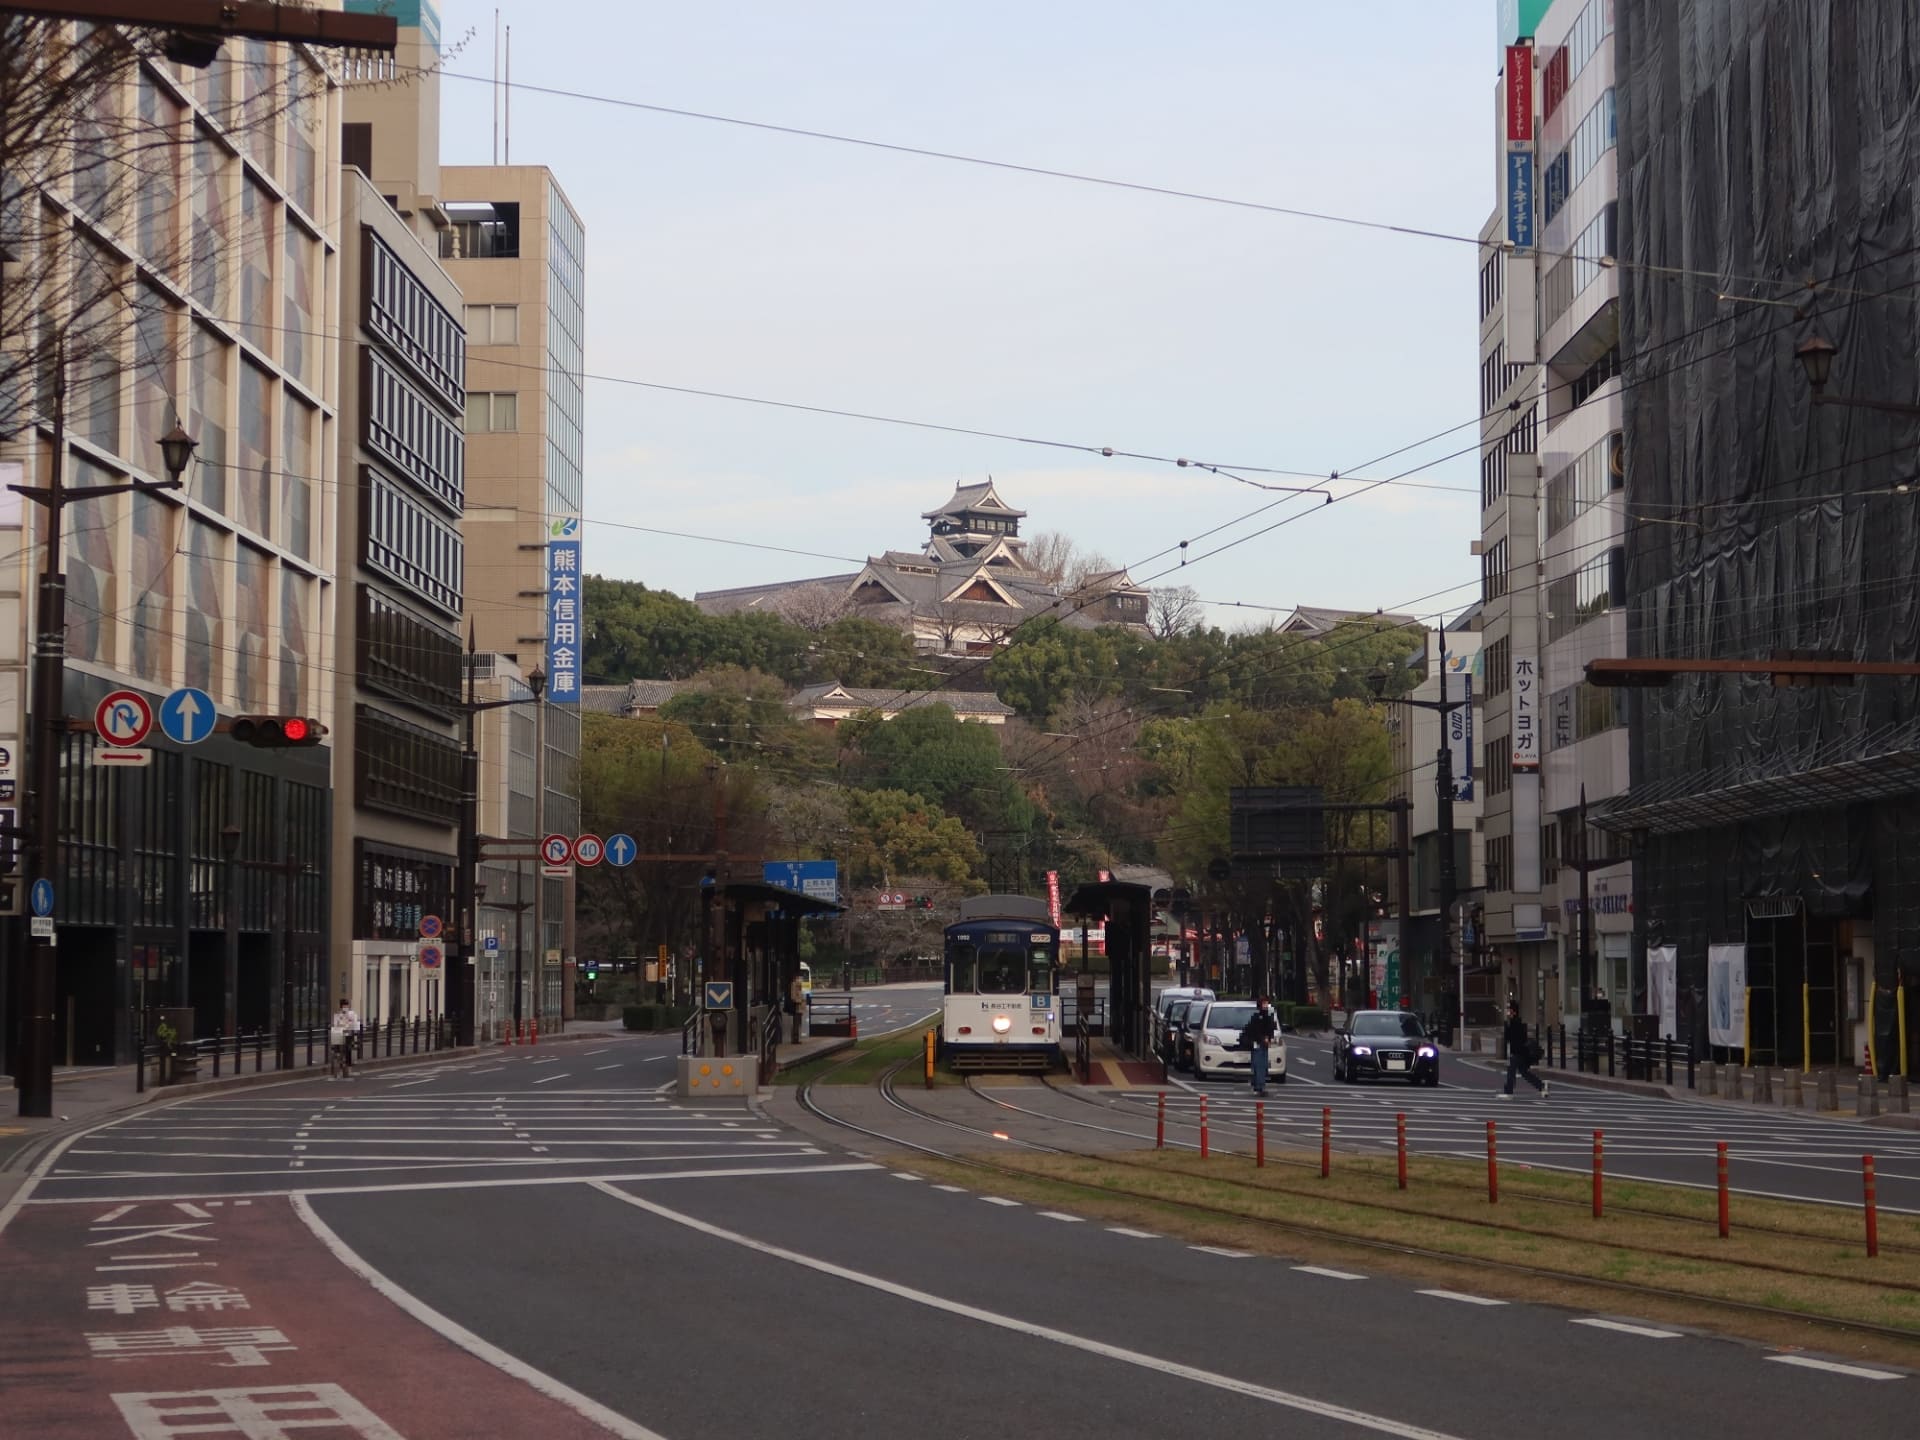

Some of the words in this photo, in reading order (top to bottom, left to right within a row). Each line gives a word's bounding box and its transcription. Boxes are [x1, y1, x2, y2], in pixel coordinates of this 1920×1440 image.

[1512, 155, 1528, 243] アートネイチャー
[552, 548, 576, 693] 熊本信用金庫
[1516, 659, 1534, 750] ホットヨガ
[579, 843, 597, 857] 40
[487, 938, 496, 949] P
[1037, 995, 1045, 1007] B
